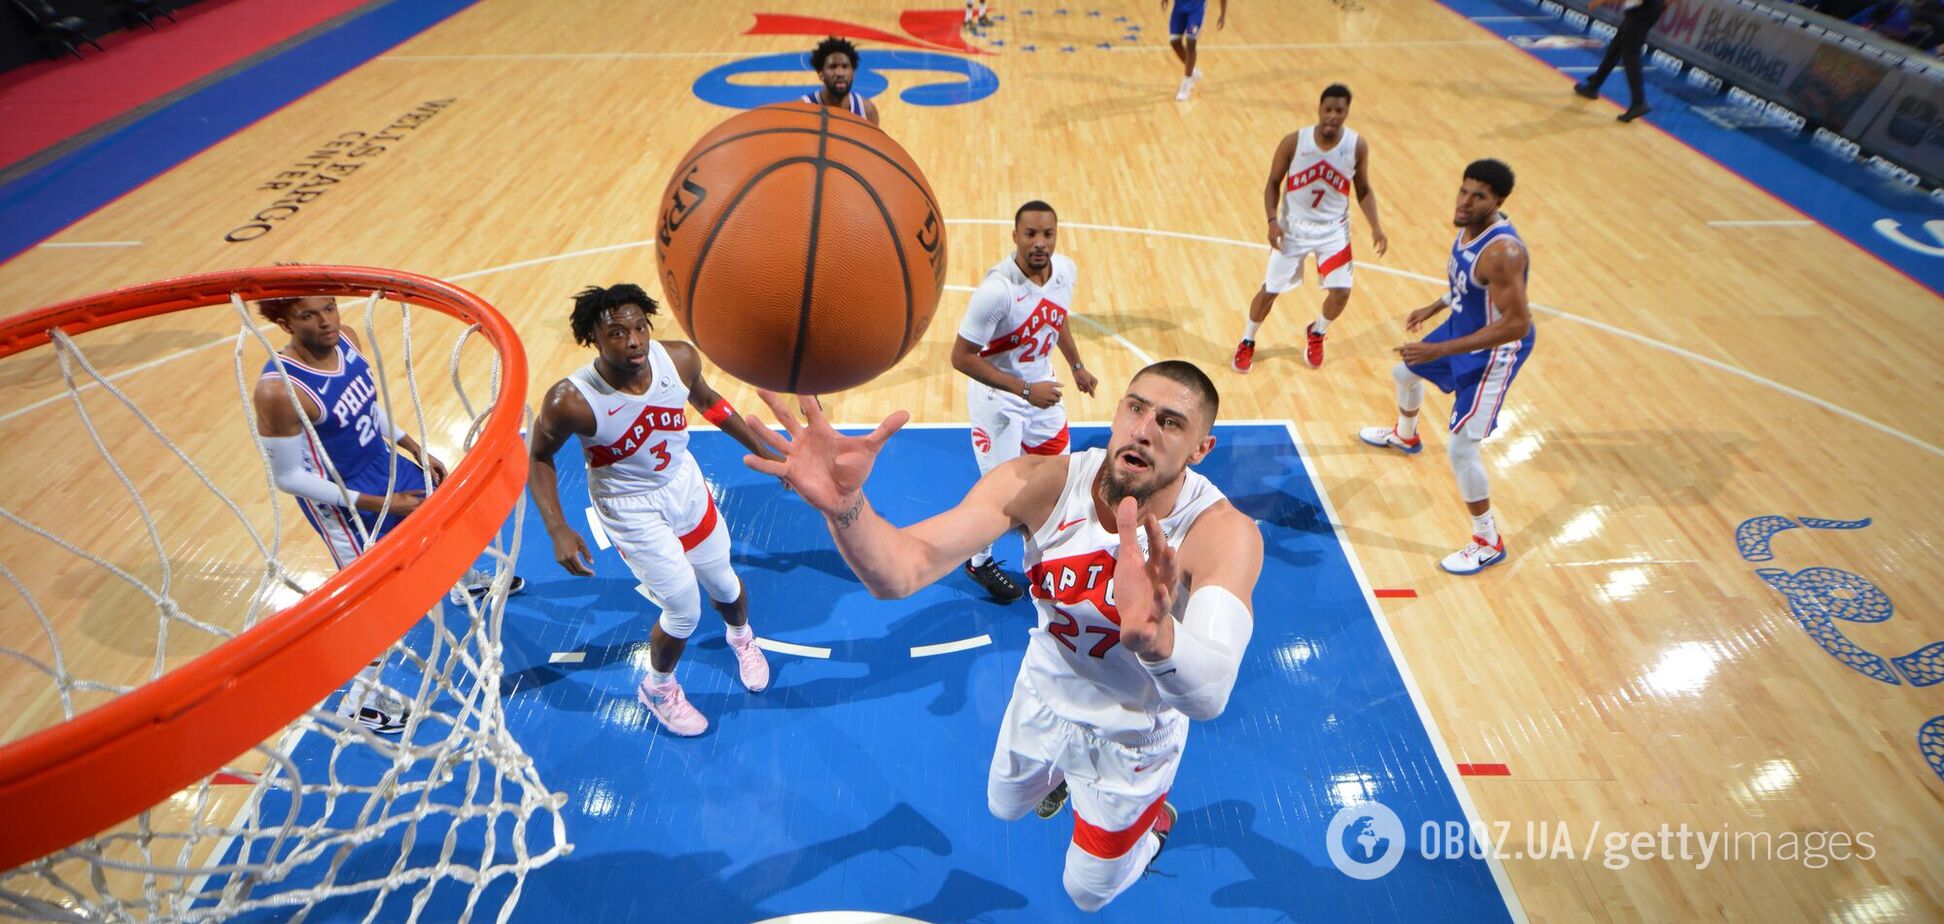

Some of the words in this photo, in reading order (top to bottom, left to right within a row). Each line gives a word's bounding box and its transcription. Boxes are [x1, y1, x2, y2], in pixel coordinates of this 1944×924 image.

[347, 97, 457, 158] WELLS
[1766, 101, 1807, 129] GEICO
[256, 130, 367, 191] CENTER
[1814, 127, 1861, 158] GEICO
[224, 162, 365, 243] FARGO
[1311, 190, 1325, 209] 7
[611, 411, 685, 456] RAPTOR
[649, 439, 672, 472] 3
[1048, 604, 1121, 660] 27
